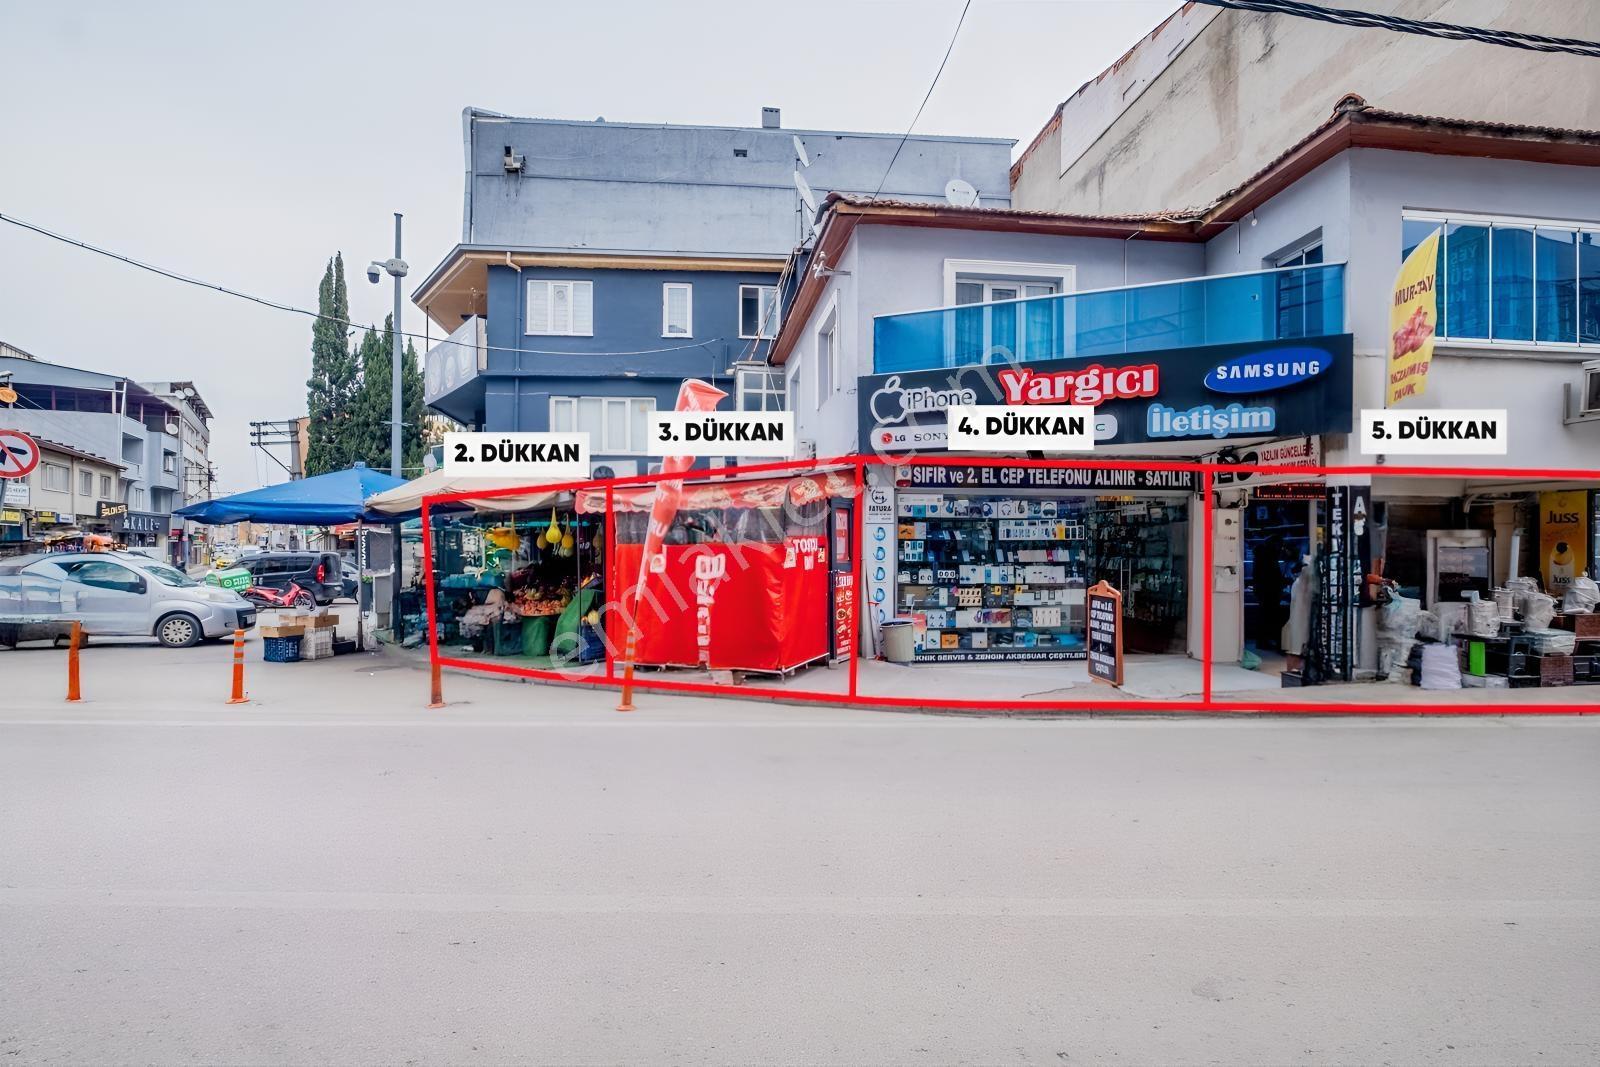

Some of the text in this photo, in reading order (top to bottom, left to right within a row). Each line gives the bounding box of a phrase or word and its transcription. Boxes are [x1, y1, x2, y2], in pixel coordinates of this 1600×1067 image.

[1216, 360, 1320, 380] SAMSUNG
[1001, 367, 1156, 404] Yargıcı
[907, 390, 973, 410] iPhone
[895, 434, 906, 442] LG
[1280, 443, 1314, 459] GÜNCELLEE
[913, 466, 946, 483] SIFIR
[949, 471, 964, 483] ve
[966, 467, 978, 483] 2.
[982, 467, 997, 484] EL
[1000, 467, 1024, 484] CEP
[1027, 468, 1092, 485] TELEFONU
[1095, 469, 1136, 486] ALINIR
[1145, 470, 1191, 487] SATILIR
[1545, 510, 1579, 524] Juss
